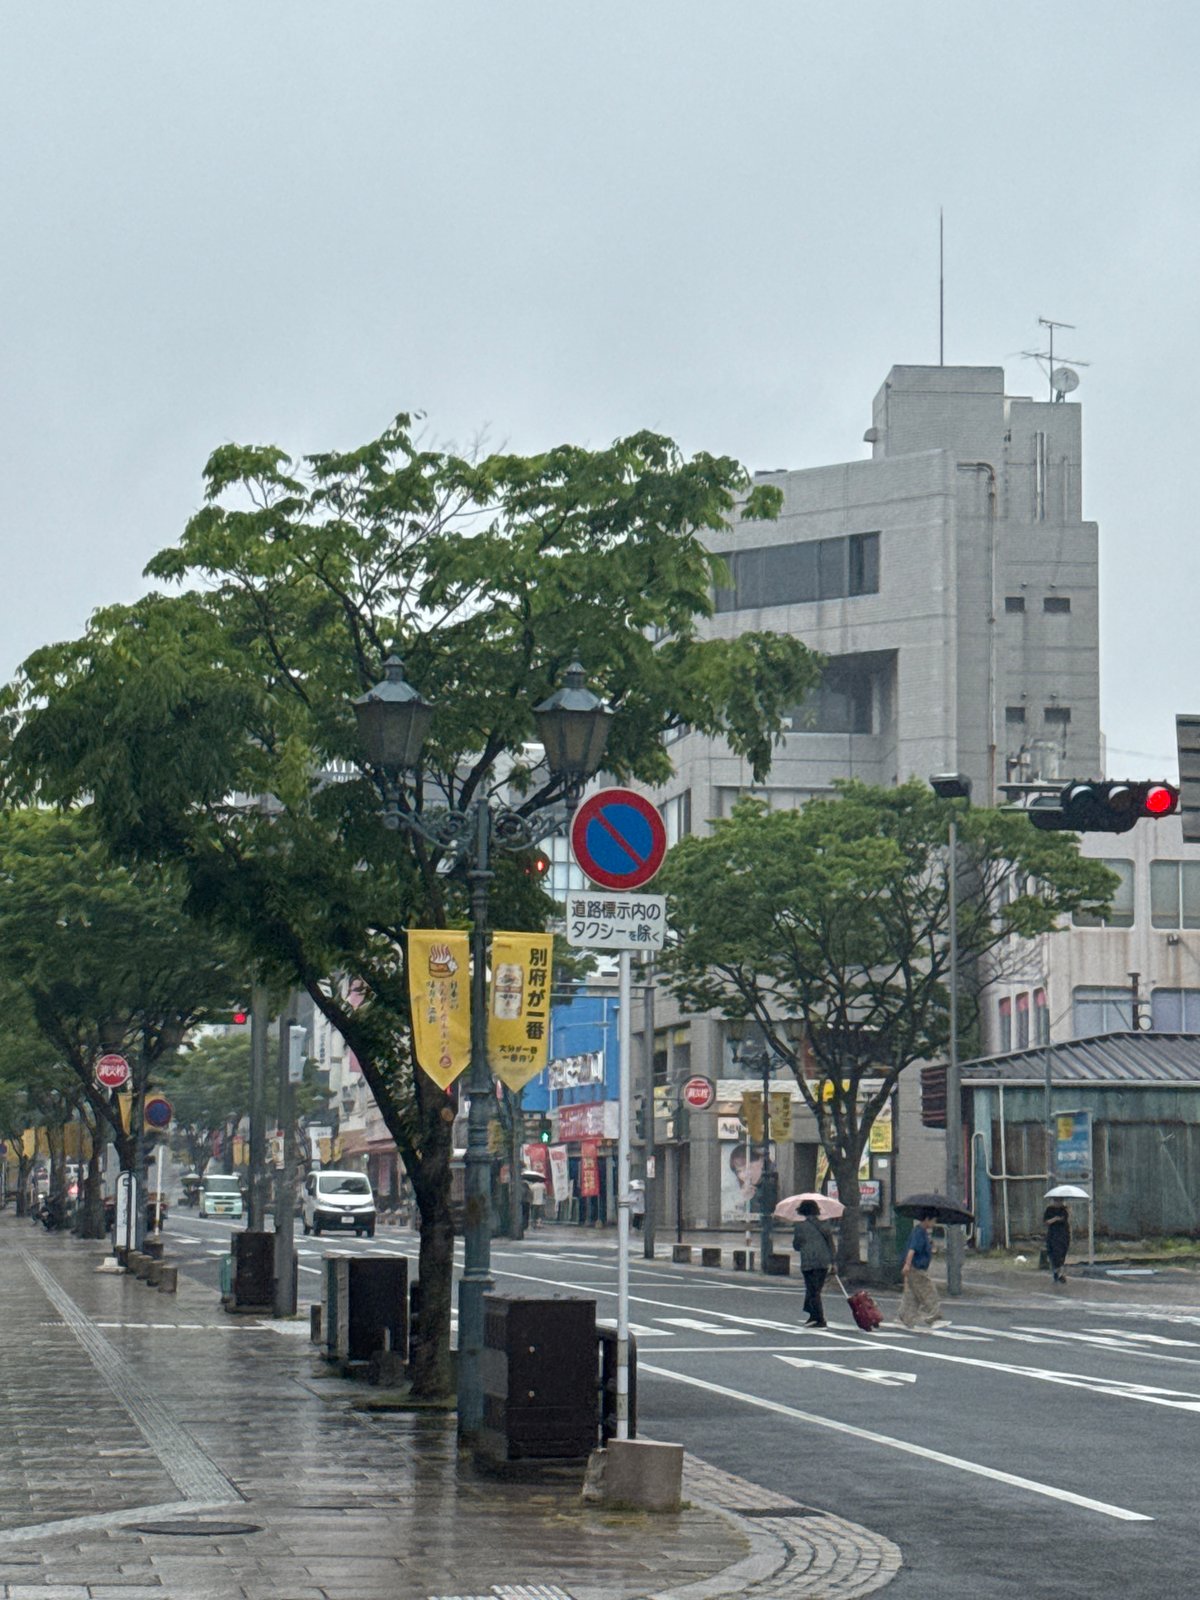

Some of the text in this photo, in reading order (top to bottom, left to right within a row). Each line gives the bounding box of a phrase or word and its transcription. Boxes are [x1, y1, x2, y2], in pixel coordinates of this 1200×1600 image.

[571, 900, 661, 920] 道路標示内の
[571, 921, 660, 942] タクシーを除く
[526, 948, 548, 1040] 別府が一番
